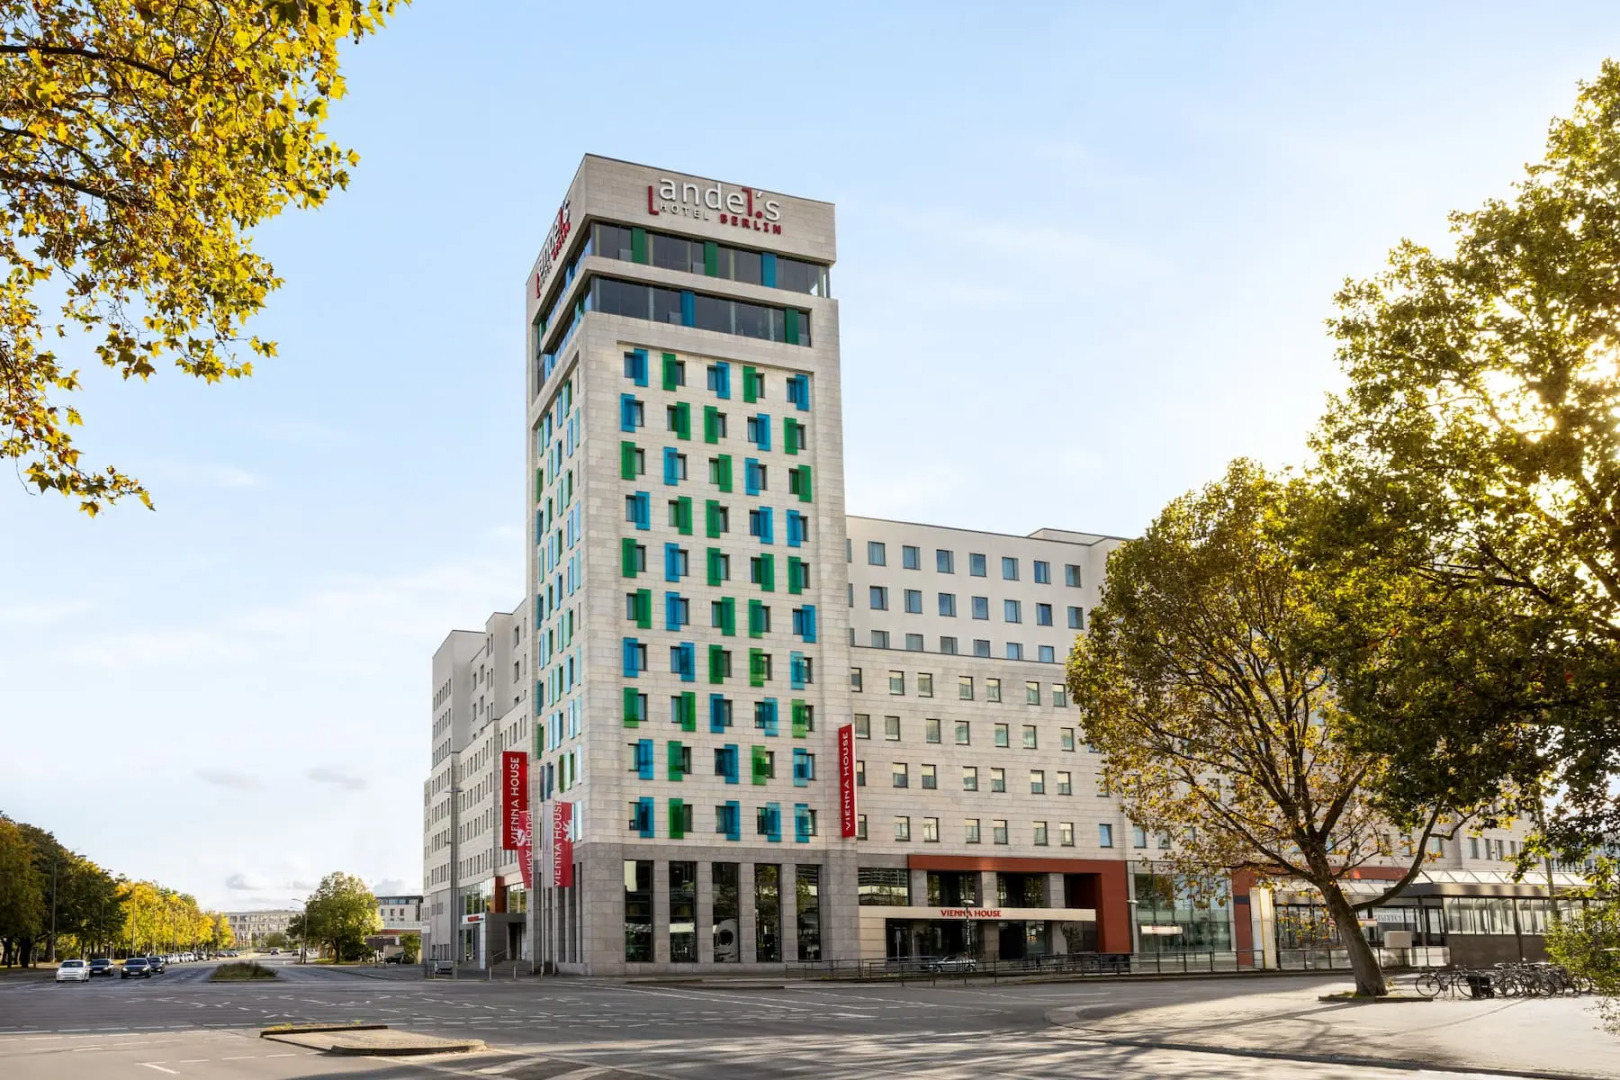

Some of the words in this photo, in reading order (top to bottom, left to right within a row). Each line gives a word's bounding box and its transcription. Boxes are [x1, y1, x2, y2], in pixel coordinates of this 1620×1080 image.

[660, 202, 709, 220] HOTEL
[719, 213, 782, 235] BERLIN
[510, 757, 520, 796] HOUSE
[510, 799, 520, 845] VIENNA
[553, 843, 562, 887] VIENNA
[940, 909, 973, 918] VIENNA
[974, 909, 1002, 918] HOUSE
